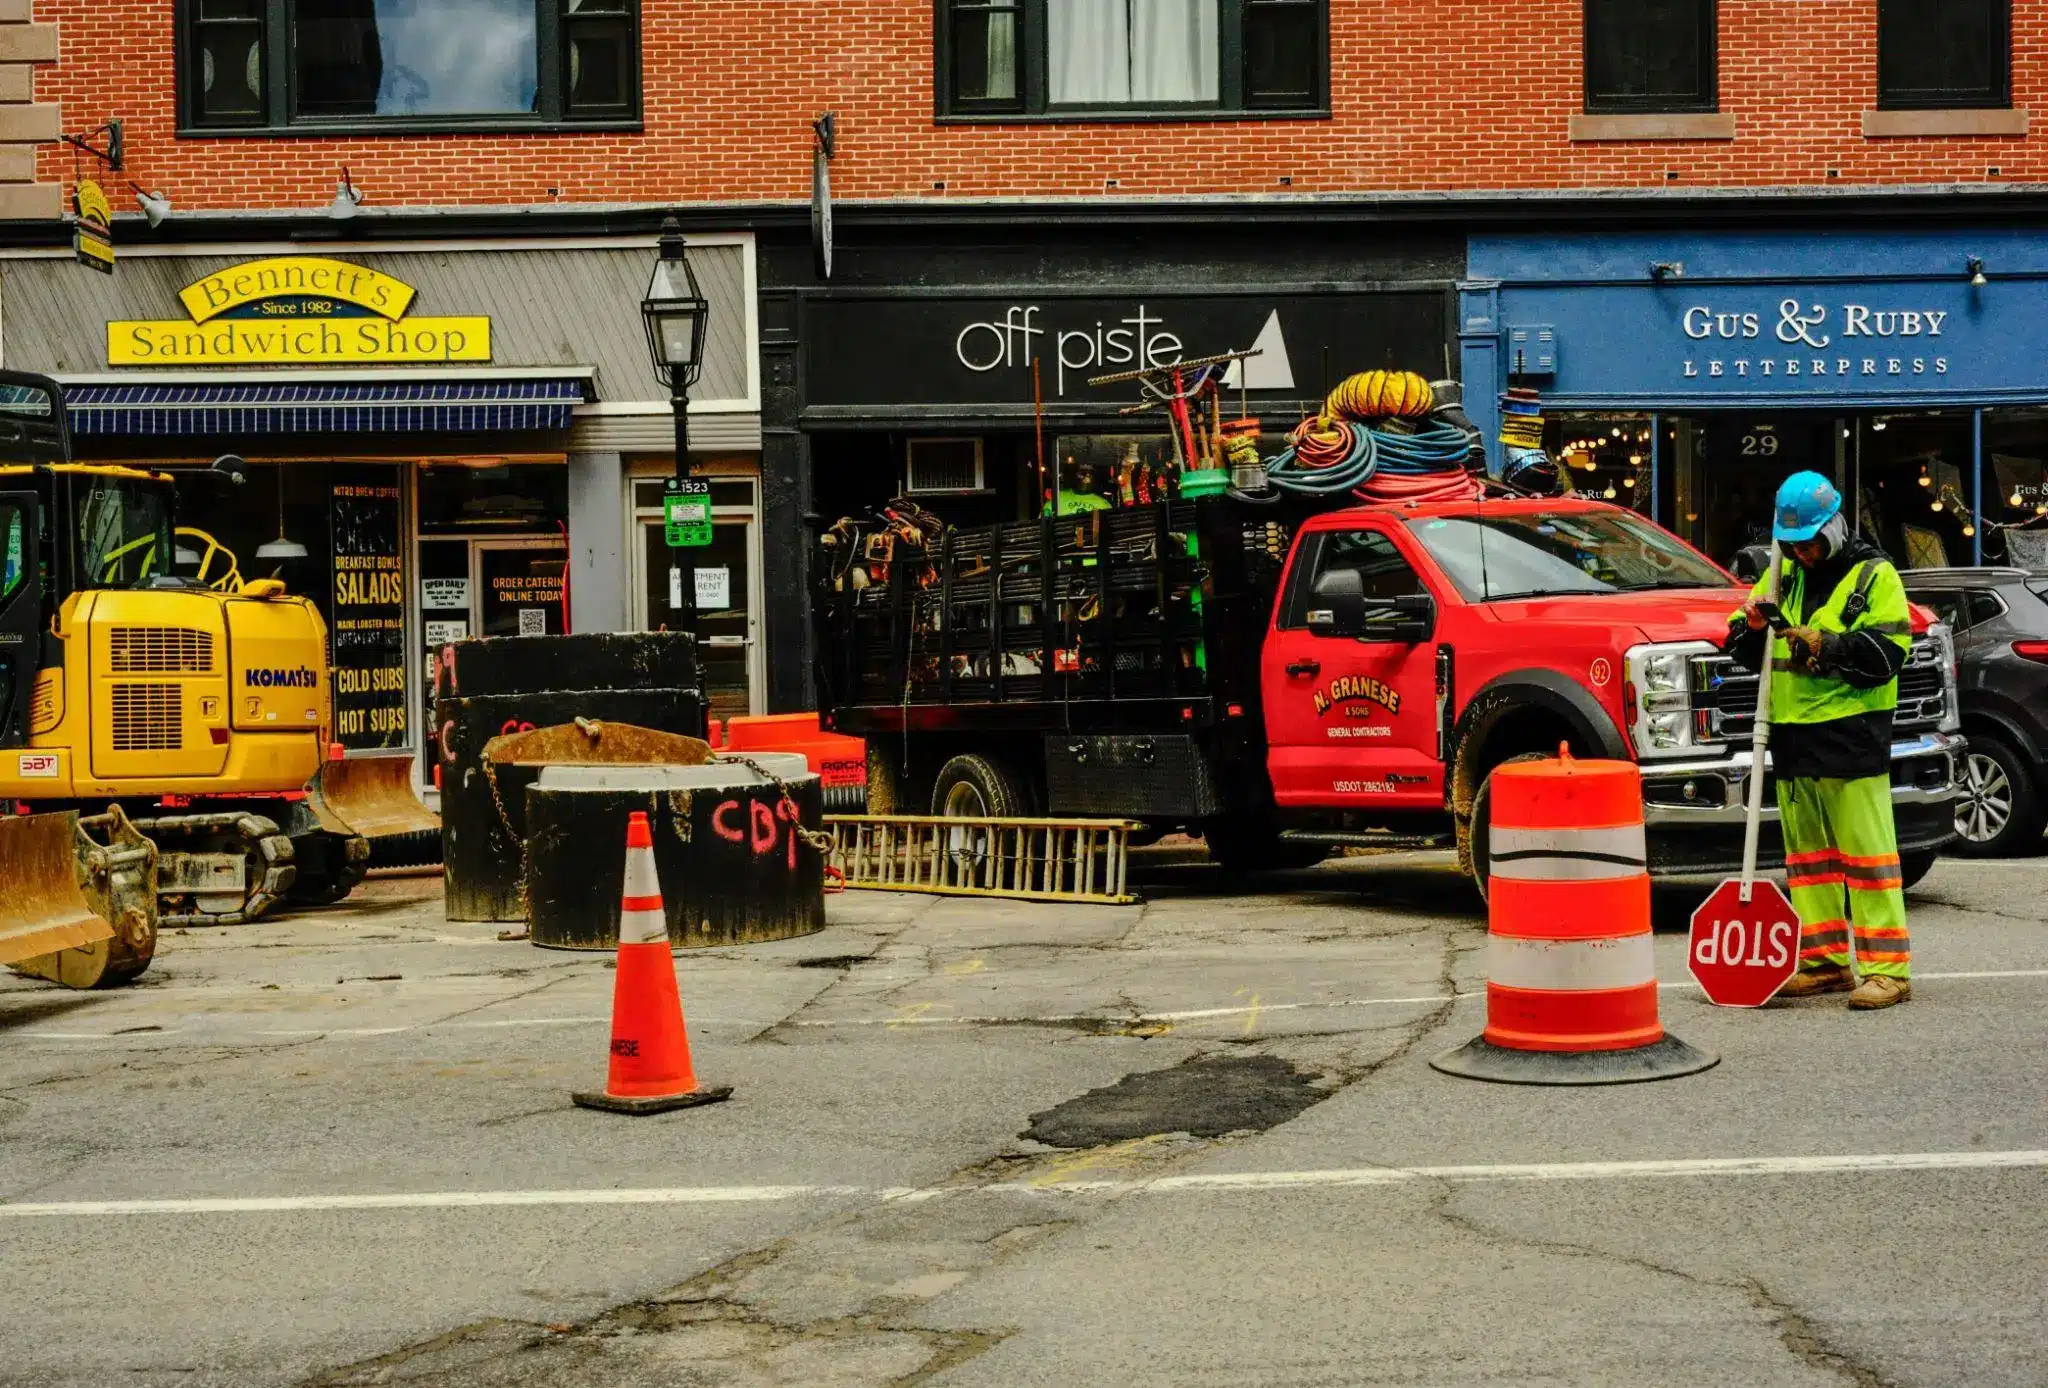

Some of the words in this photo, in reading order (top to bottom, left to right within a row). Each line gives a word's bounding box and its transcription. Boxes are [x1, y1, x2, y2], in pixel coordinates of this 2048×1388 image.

[199, 265, 392, 310] Bennett's
[262, 302, 296, 314] Since
[301, 301, 332, 314] 1982
[1775, 299, 1830, 348] &
[131, 322, 344, 358] Sandwich
[357, 321, 467, 360] Shop
[956, 305, 1044, 372] off
[1058, 304, 1183, 396] piste
[1683, 358, 1948, 377] LETTERPRESS
[1741, 435, 1779, 456] 29
[333, 485, 354, 497] NITRO
[355, 486, 374, 497] BREW
[681, 482, 708, 493] 1523
[335, 556, 376, 570] BREAKFAST
[377, 556, 401, 569] BOWLS
[336, 571, 402, 605] SALADS
[425, 580, 444, 590] OPEN
[445, 580, 466, 589] DAILY
[492, 577, 523, 589] ORDER
[525, 576, 564, 588] CATERIN
[697, 582, 722, 590] RENT
[499, 590, 533, 602] ONLINE
[535, 590, 564, 602] TODAY
[337, 620, 356, 629] MAINE
[357, 619, 383, 629] LOBSTER
[384, 619, 404, 629] ROLLS
[246, 665, 317, 688] KOMATSU
[338, 668, 370, 693] COLD
[372, 667, 404, 692] SUBS
[1595, 666, 1606, 680] 92
[1313, 690, 1330, 714] N.
[1330, 675, 1401, 714] GRANESE
[1345, 706, 1350, 716] &
[1351, 706, 1369, 716] SONS
[339, 709, 366, 734] HOT
[370, 707, 405, 733] SUBS
[1327, 727, 1352, 738] GENERAL
[1352, 726, 1392, 737] CONTRACTORS
[1333, 780, 1361, 792] USDOT
[1695, 919, 1792, 969] STOP
